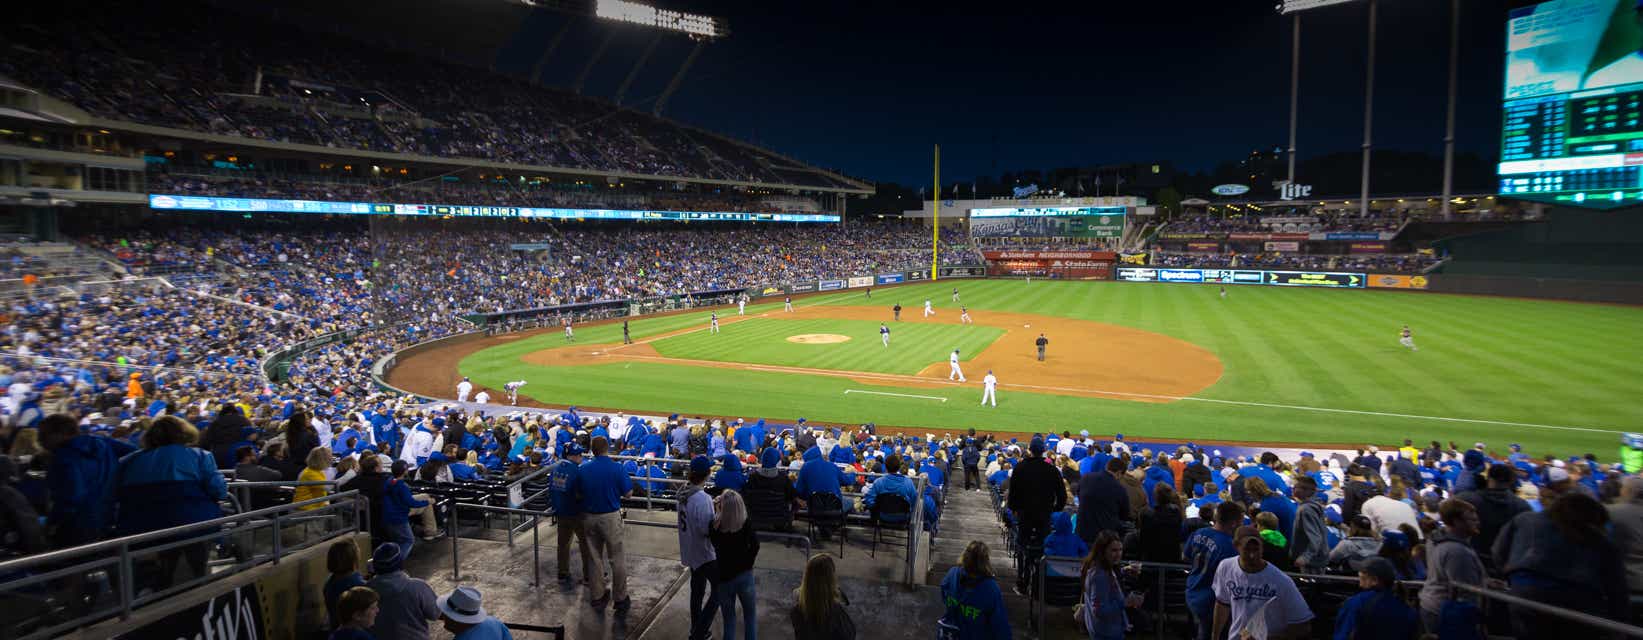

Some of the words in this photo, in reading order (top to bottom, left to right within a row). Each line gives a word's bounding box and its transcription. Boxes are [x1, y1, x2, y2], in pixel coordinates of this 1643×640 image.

[1280, 182, 1313, 201] Lite
[972, 221, 1015, 237] Kansas
[1161, 271, 1201, 281] Spectrum
[1226, 580, 1278, 602] Royals
